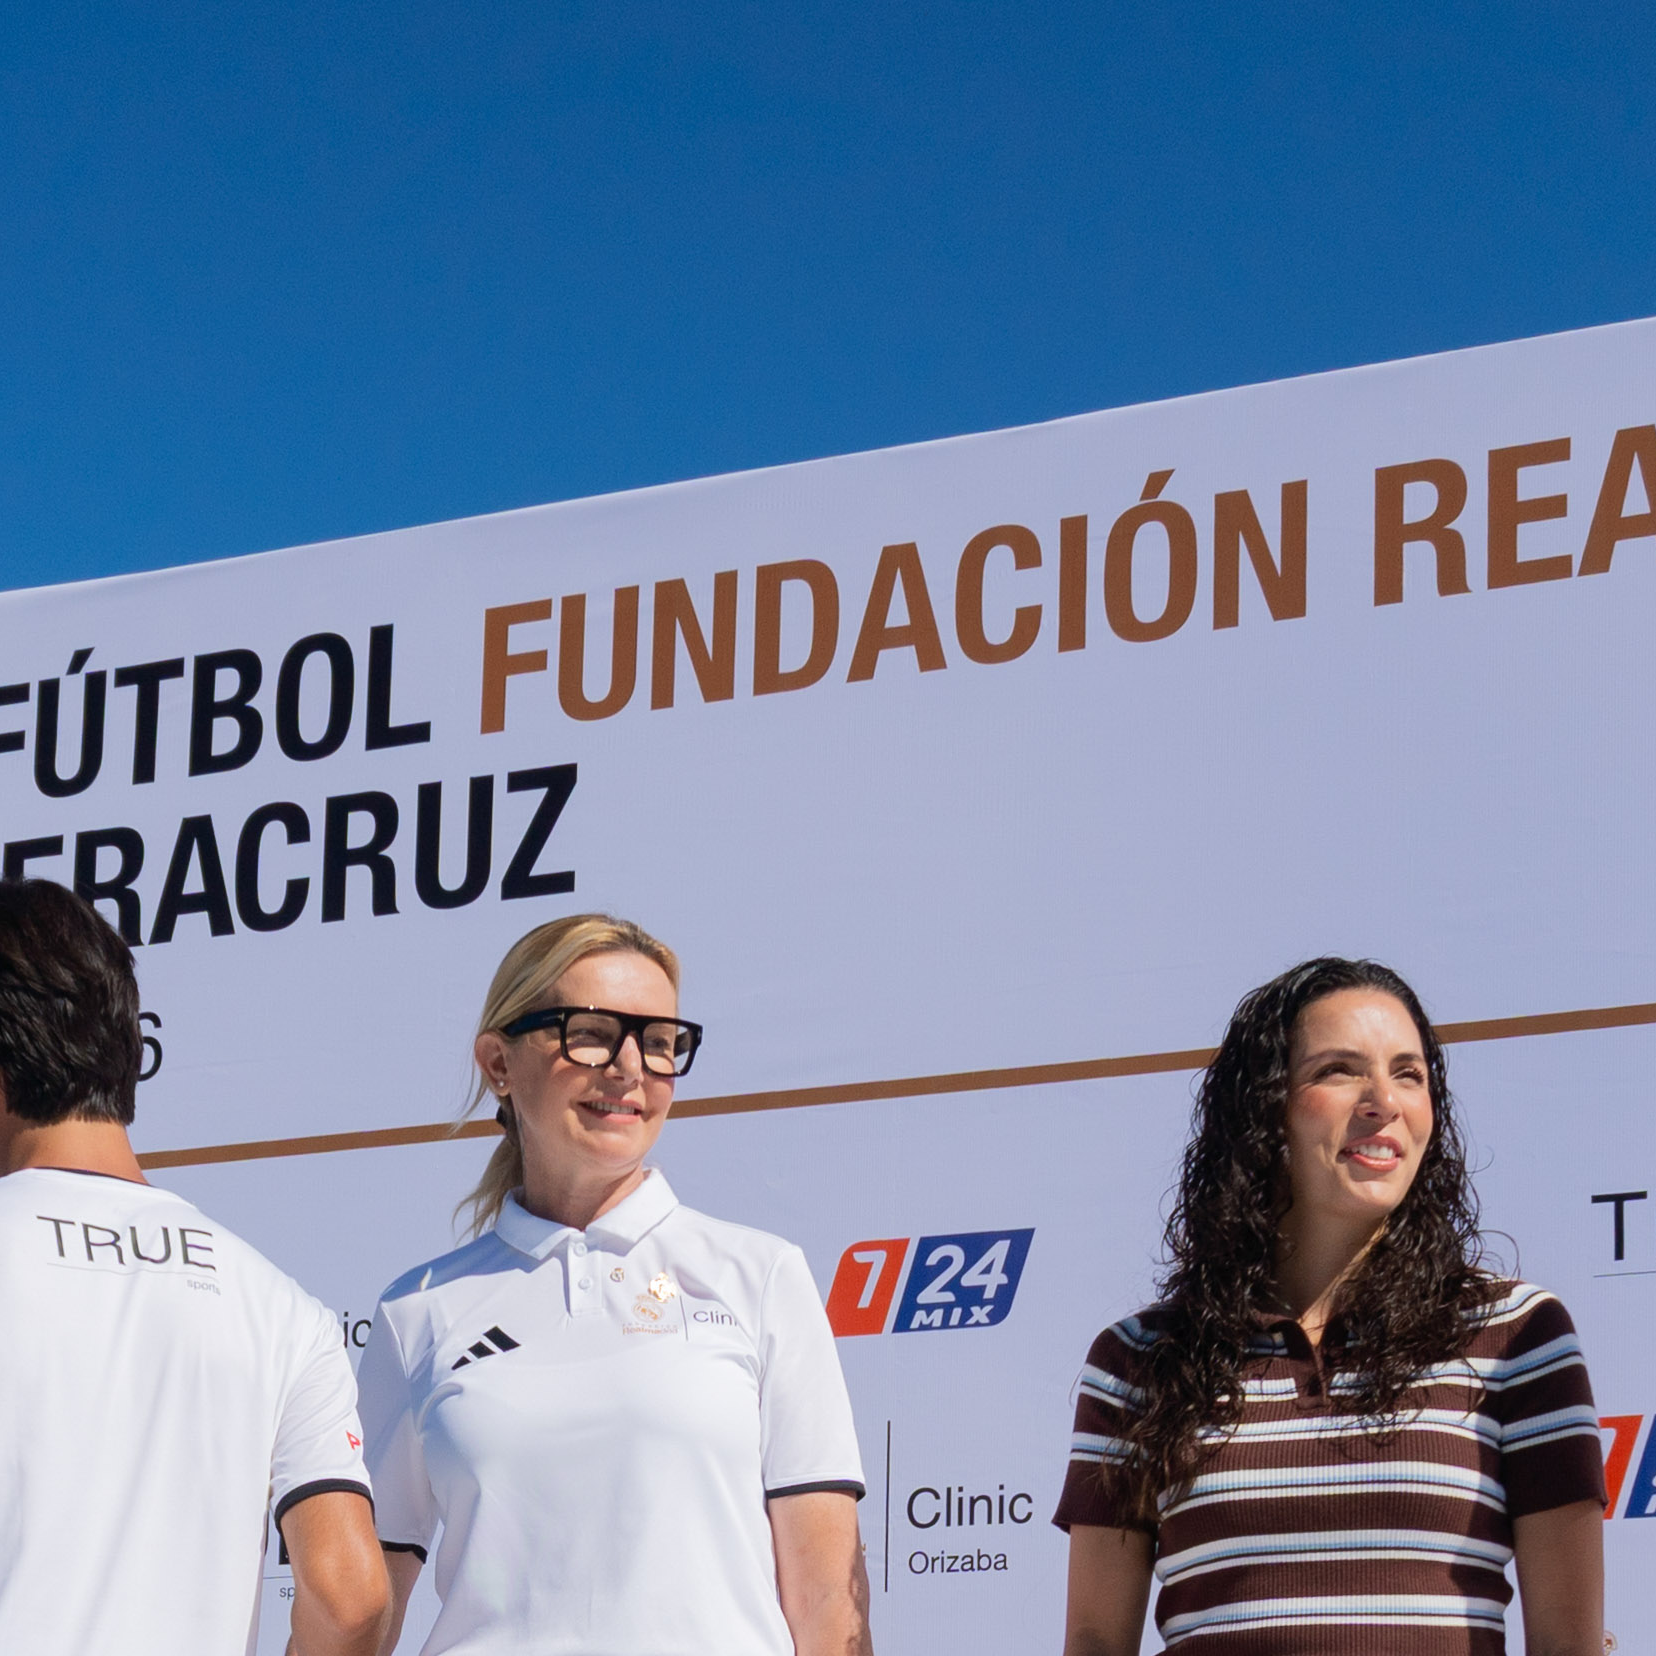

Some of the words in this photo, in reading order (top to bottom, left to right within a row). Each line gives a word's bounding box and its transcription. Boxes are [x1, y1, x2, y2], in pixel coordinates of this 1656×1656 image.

[480, 468, 1308, 735] FUNDACIÓN
[36, 1214, 216, 1272] TRUE
[917, 1240, 1010, 1304] 24
[693, 1310, 739, 1327] Clin
[909, 1305, 994, 1328] MIX
[907, 1484, 1032, 1529] Clinic
[909, 1549, 1008, 1574] Orizaba
